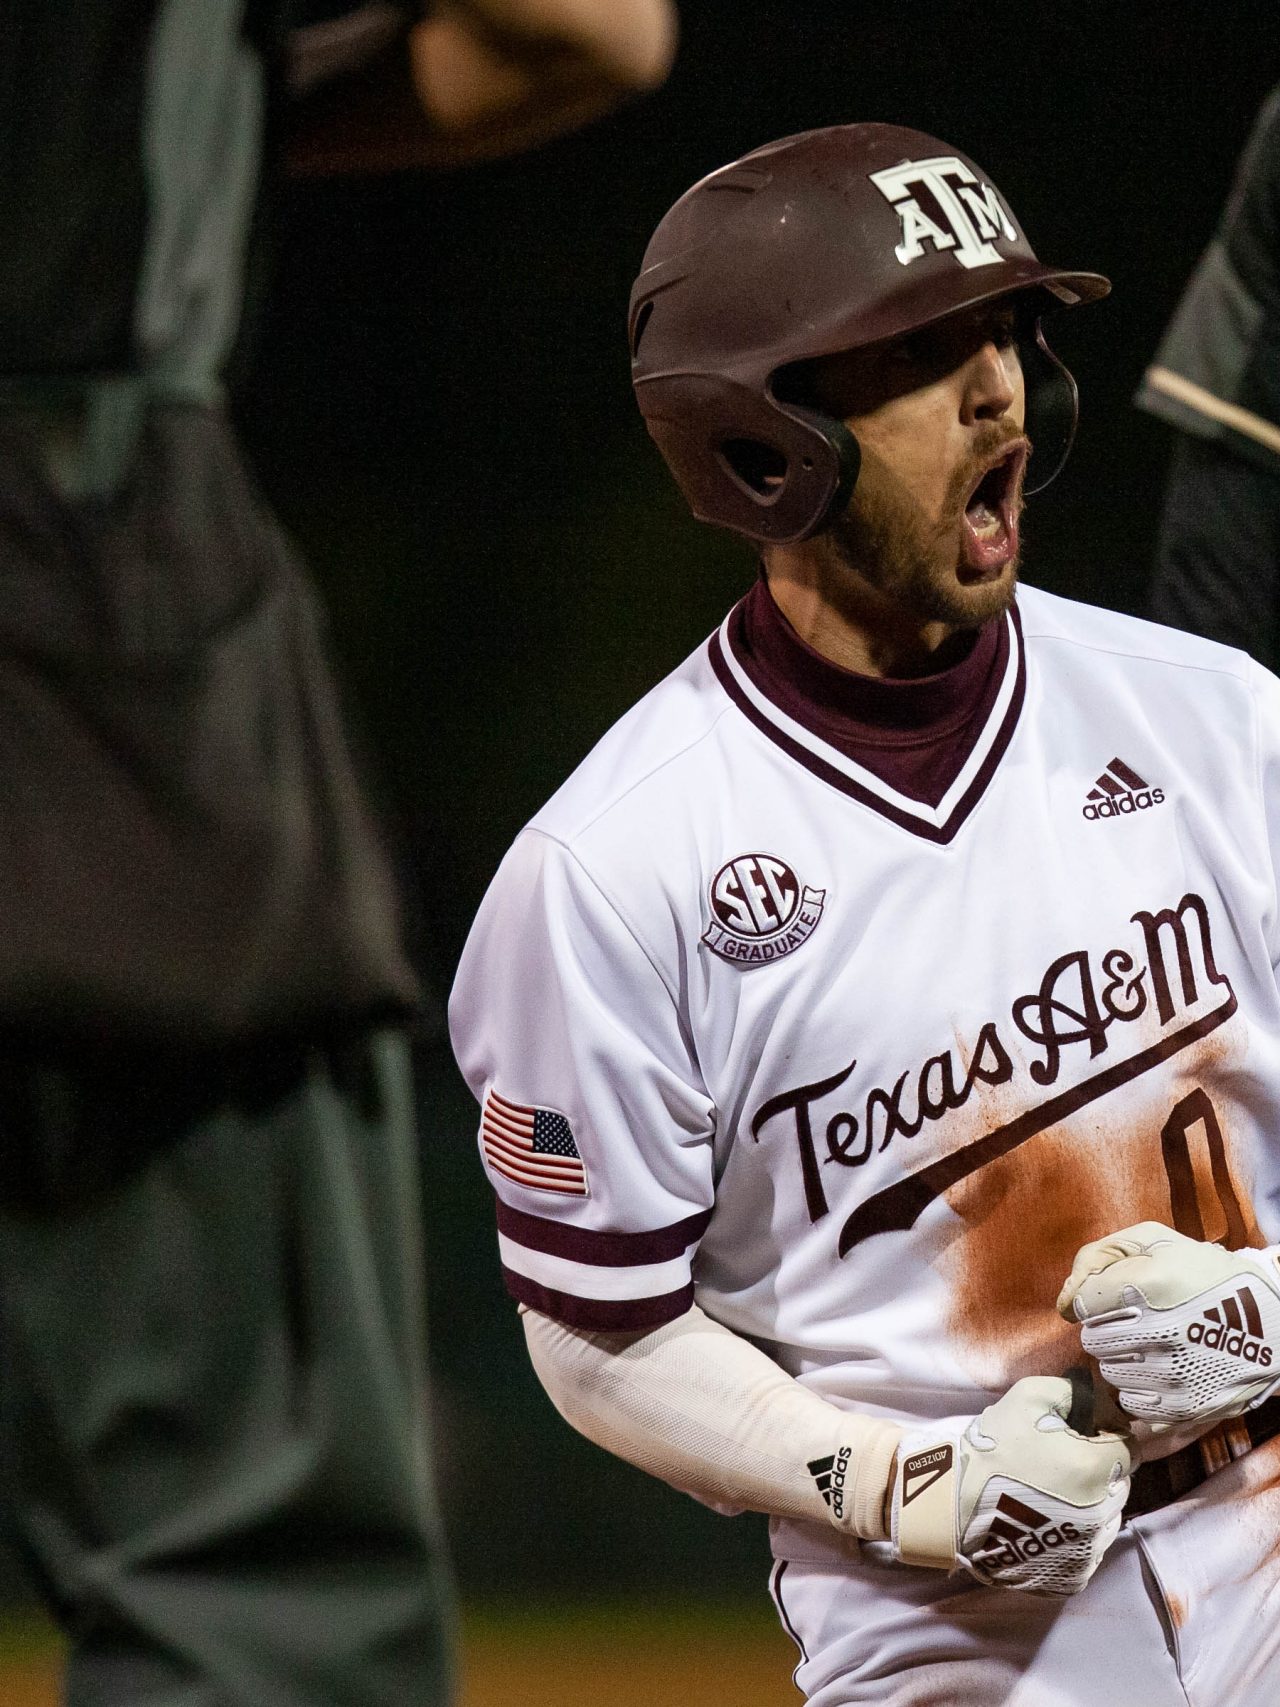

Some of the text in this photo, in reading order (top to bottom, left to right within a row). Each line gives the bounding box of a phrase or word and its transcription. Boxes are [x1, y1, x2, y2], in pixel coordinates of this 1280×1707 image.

[1082, 788, 1165, 820] adidas
[716, 857, 796, 933] SEC
[723, 911, 817, 960] GRADUATE
[751, 893, 1238, 1225] Texas A&M
[1161, 1087, 1250, 1250] 0
[1187, 1322, 1273, 1367] adidas
[829, 1446, 852, 1519] adidas
[908, 1449, 948, 1471] ADIZERO
